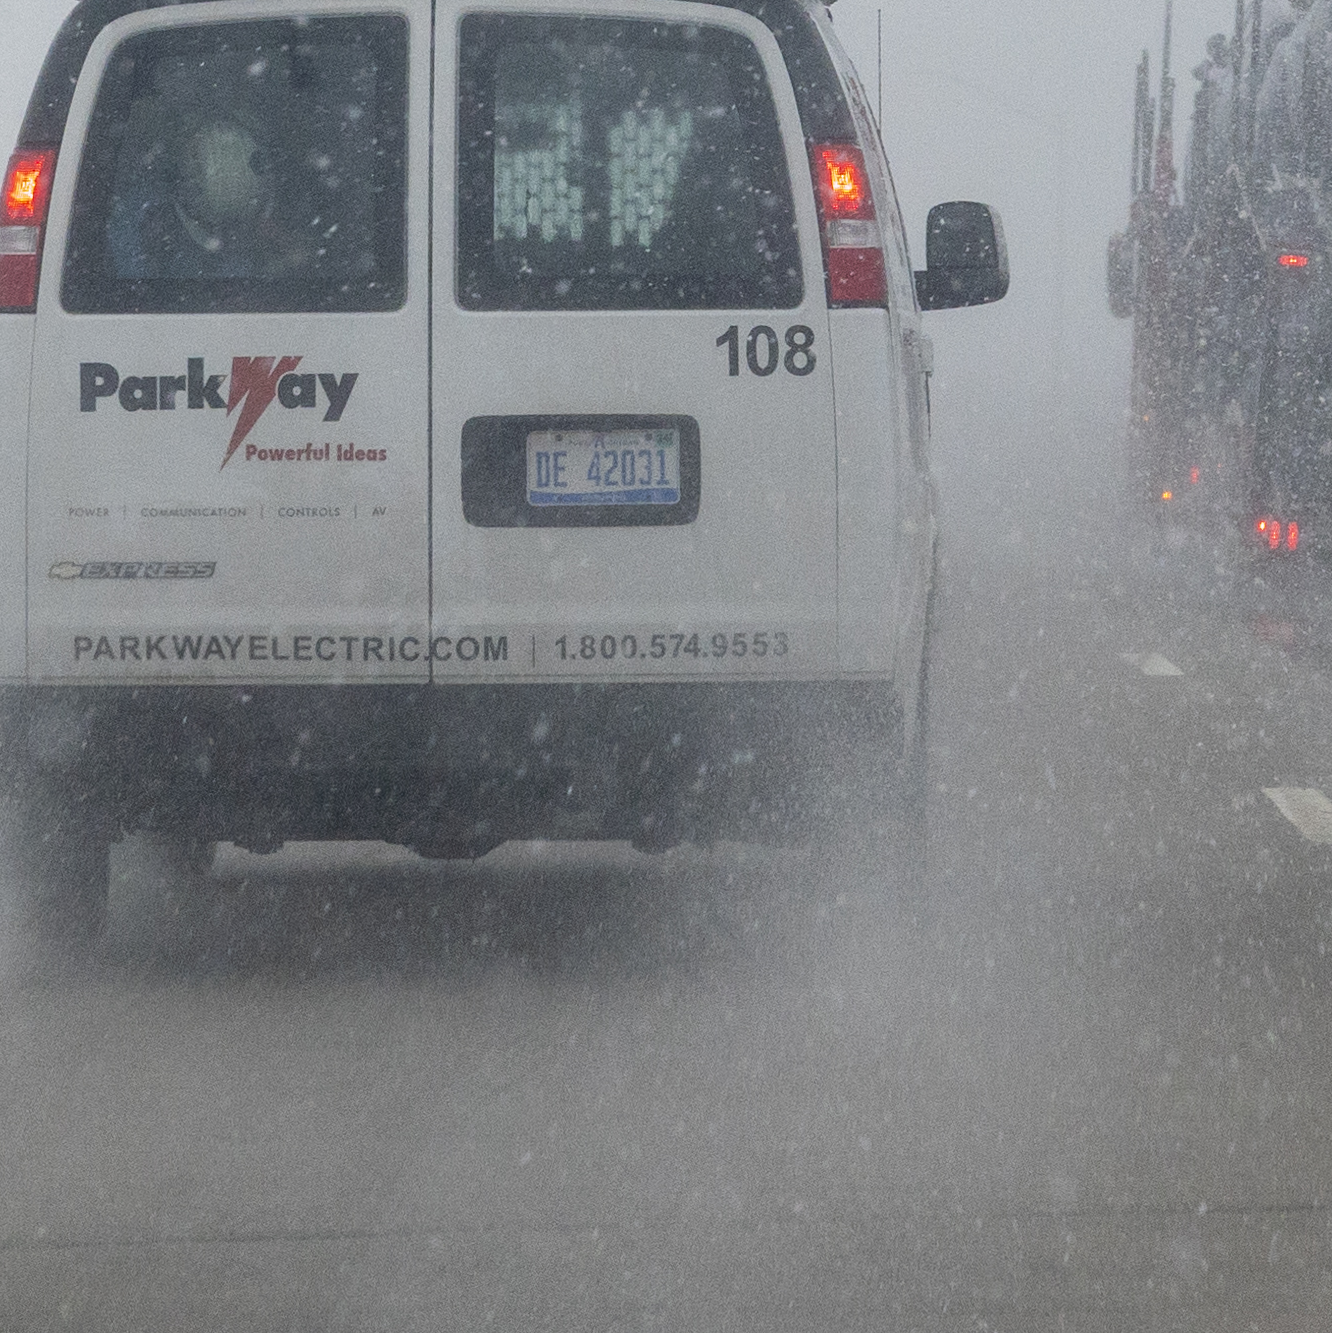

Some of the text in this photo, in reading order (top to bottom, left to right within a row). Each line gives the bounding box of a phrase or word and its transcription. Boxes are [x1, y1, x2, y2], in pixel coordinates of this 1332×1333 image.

[715, 324, 817, 377] 108
[245, 443, 387, 462] Powerful Ideas
[536, 449, 670, 488] DE 42031
[68, 506, 387, 518] POWER COMMUNICATION CONTROLS AV
[80, 561, 216, 579] EXPRESS
[73, 632, 789, 662] PARKWAYELECTRIC.COM 1.800.574.9553
